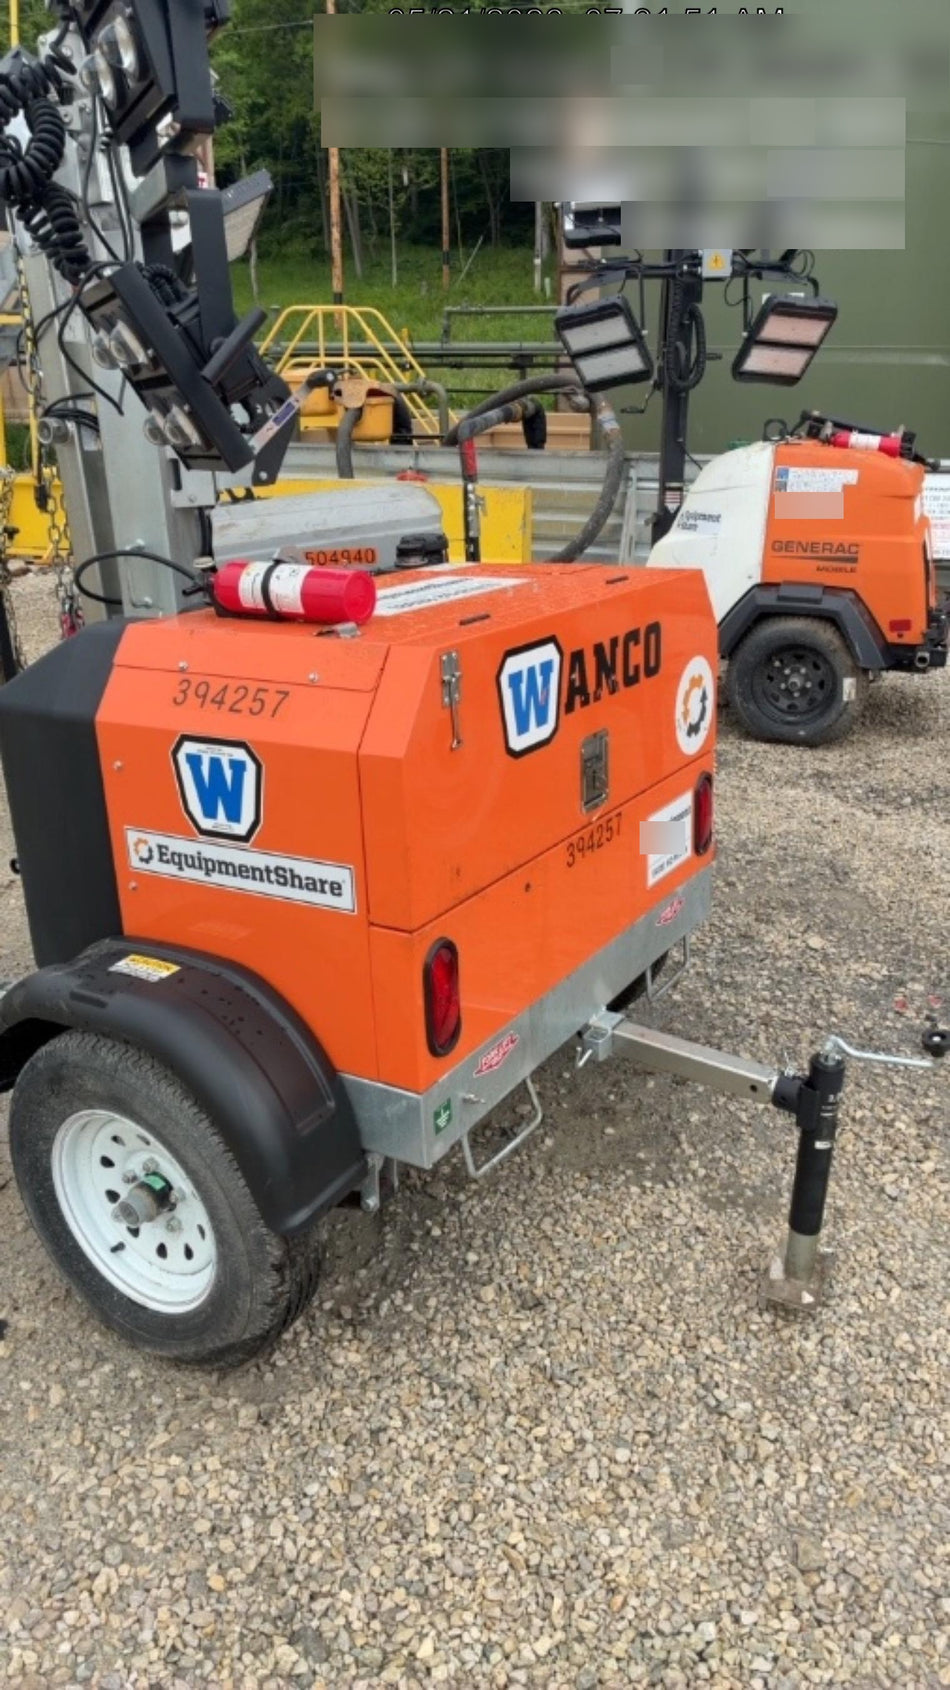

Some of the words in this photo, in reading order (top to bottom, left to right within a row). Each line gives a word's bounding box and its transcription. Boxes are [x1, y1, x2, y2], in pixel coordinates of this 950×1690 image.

[771, 540, 860, 555] GENERAC
[172, 678, 290, 719] 394257
[185, 752, 247, 825] W
[566, 812, 623, 868] 394257
[156, 843, 344, 897] EquipmentShare
